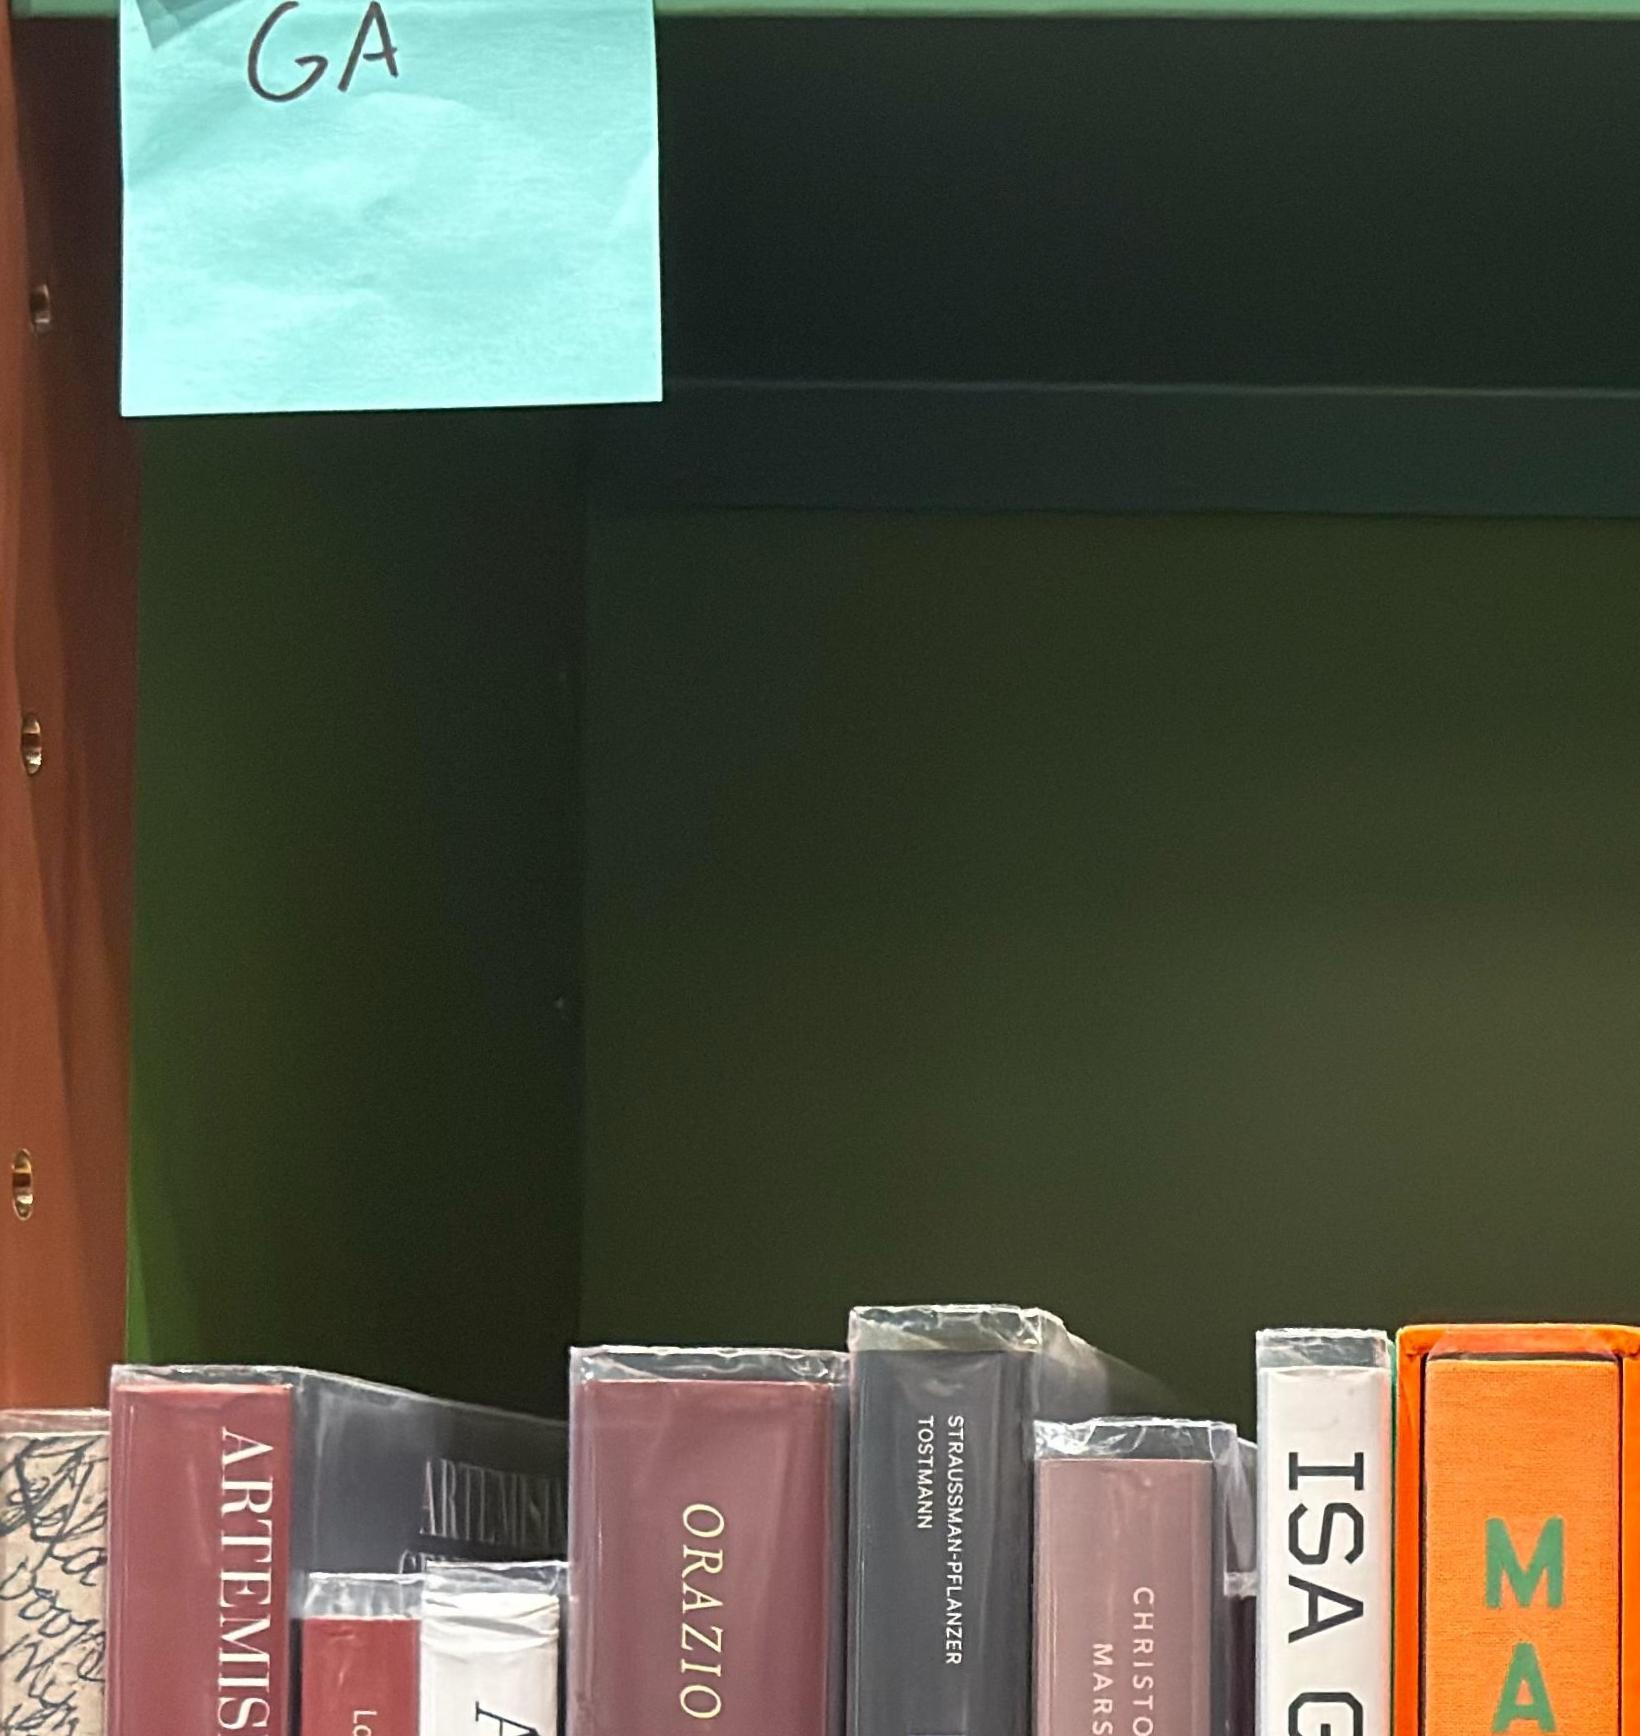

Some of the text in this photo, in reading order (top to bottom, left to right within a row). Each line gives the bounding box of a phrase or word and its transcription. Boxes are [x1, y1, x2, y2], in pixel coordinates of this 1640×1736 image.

[248, 1, 398, 102] GA
[916, 1414, 936, 1530] TOSTMANN
[944, 1414, 966, 1665] STRAUSSMAN-PFLANZER
[1287, 1450, 1365, 1644] ISA
[679, 1501, 724, 1720] ORAZIO
